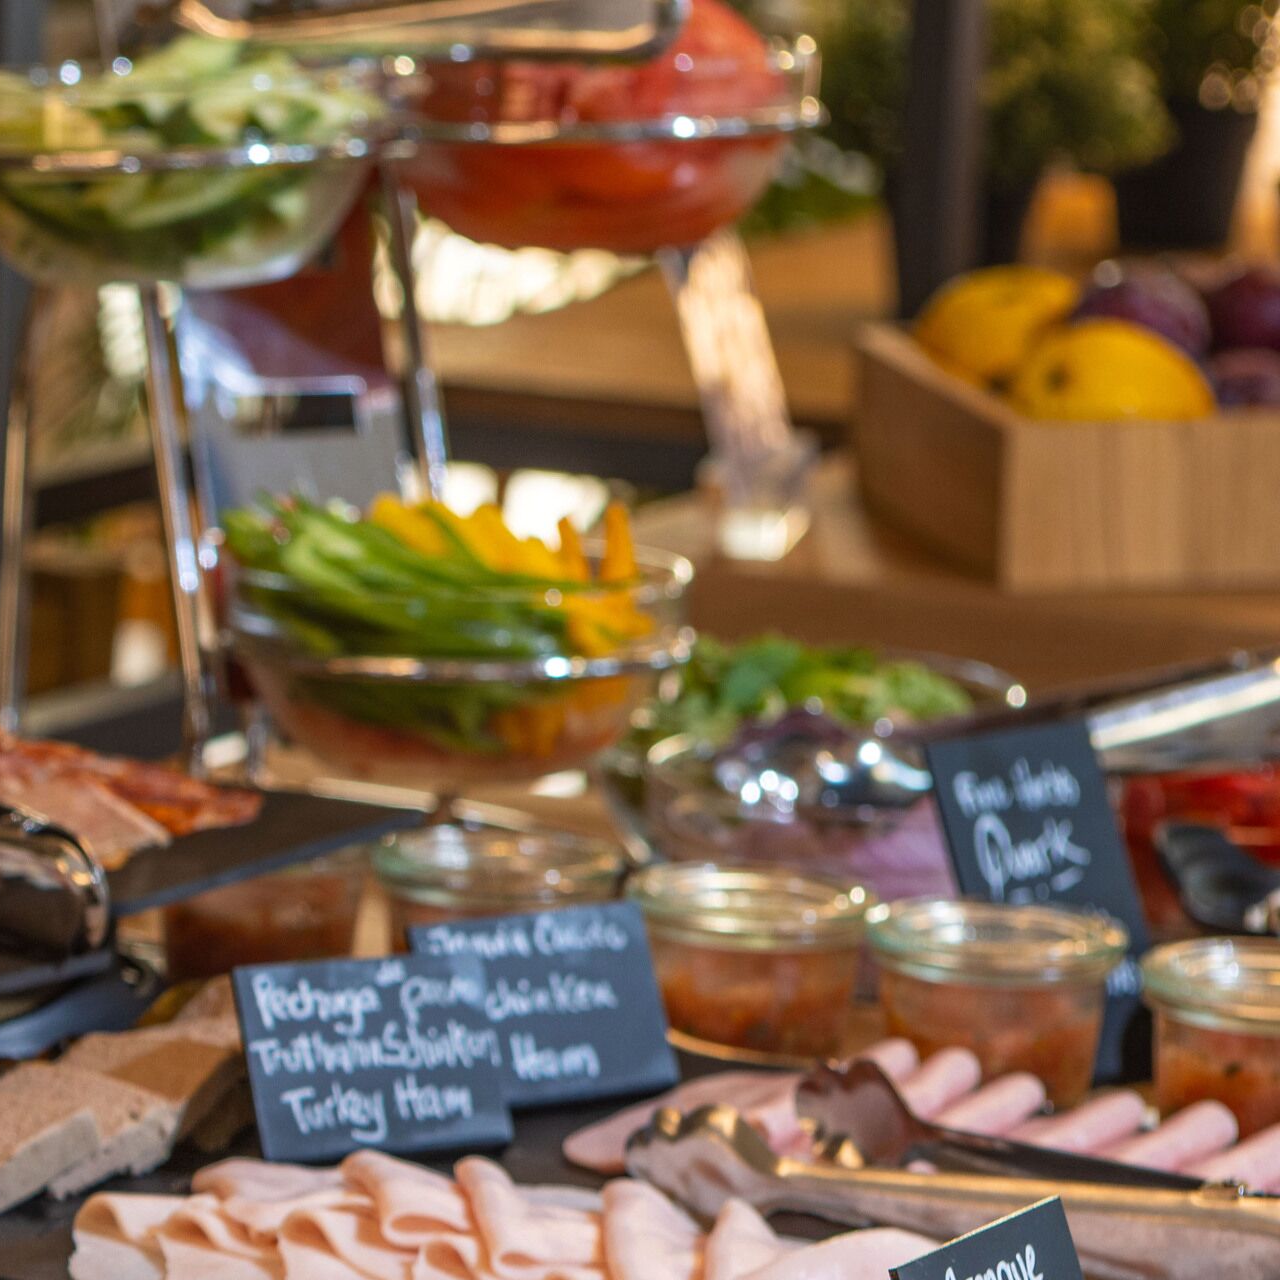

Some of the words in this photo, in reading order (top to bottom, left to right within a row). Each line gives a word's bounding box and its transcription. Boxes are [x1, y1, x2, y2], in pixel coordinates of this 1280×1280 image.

[251, 972, 381, 1035] Pechuga
[485, 971, 619, 1022] chinken
[509, 1031, 601, 1082] Ham
[280, 1081, 388, 1143] Turkey
[393, 1073, 473, 1122] Ham
